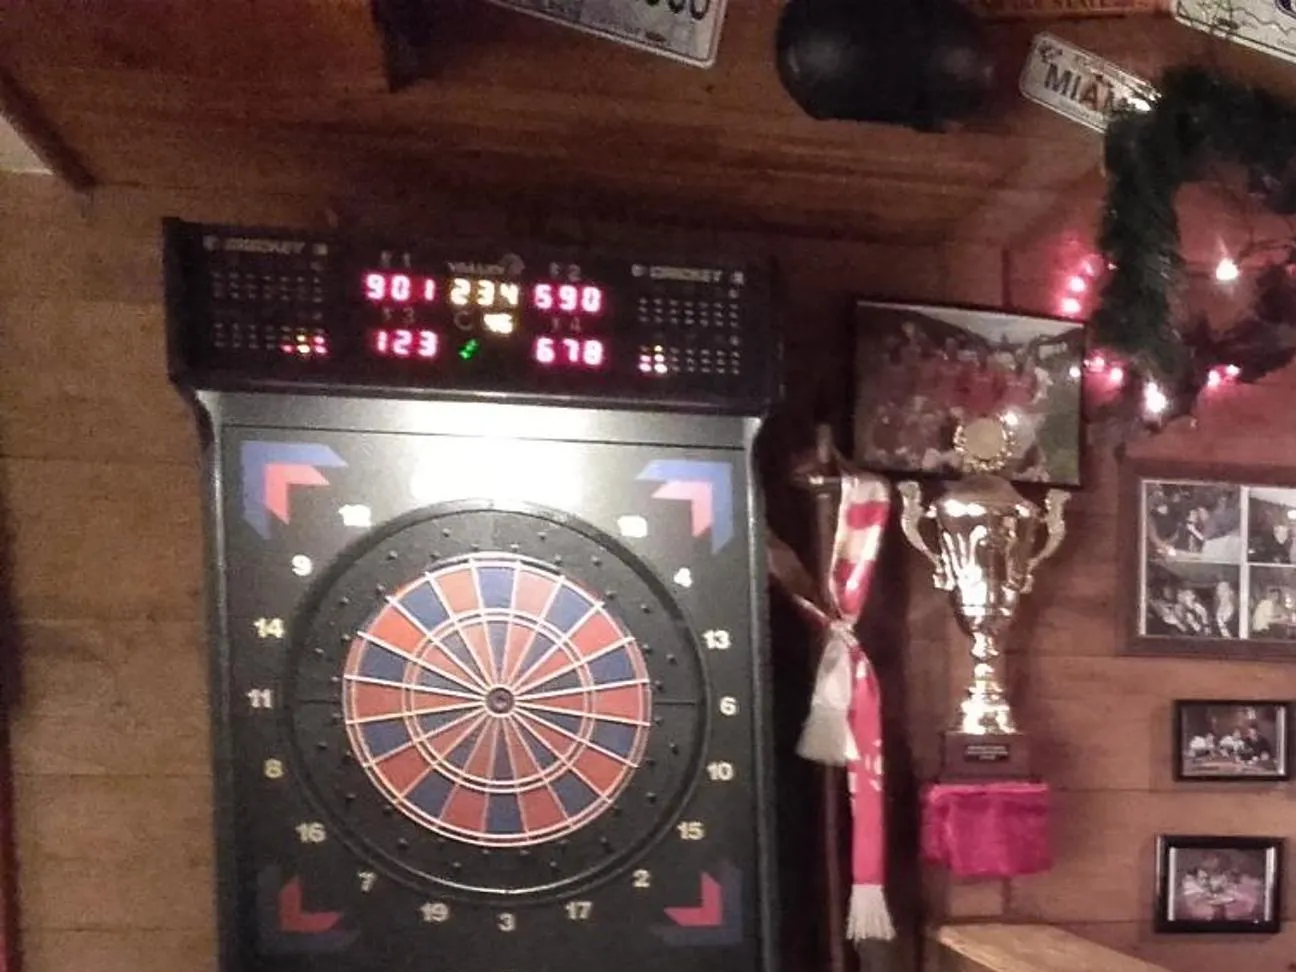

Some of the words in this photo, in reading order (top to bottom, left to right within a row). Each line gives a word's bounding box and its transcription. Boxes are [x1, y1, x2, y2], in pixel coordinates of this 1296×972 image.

[450, 278, 519, 306] 234
[377, 330, 438, 357] 123
[535, 337, 604, 365] 678
[291, 554, 313, 577] 9
[253, 617, 285, 639] 14
[703, 629, 731, 650] 13
[247, 688, 272, 708] 11
[719, 696, 737, 716] 6
[707, 761, 734, 781] 10
[295, 822, 326, 843] 16
[677, 821, 704, 841] 15
[357, 871, 376, 892] 7
[633, 869, 650, 888] 2
[420, 902, 449, 922] 19
[565, 901, 593, 920] 17
[498, 912, 515, 932] 3
